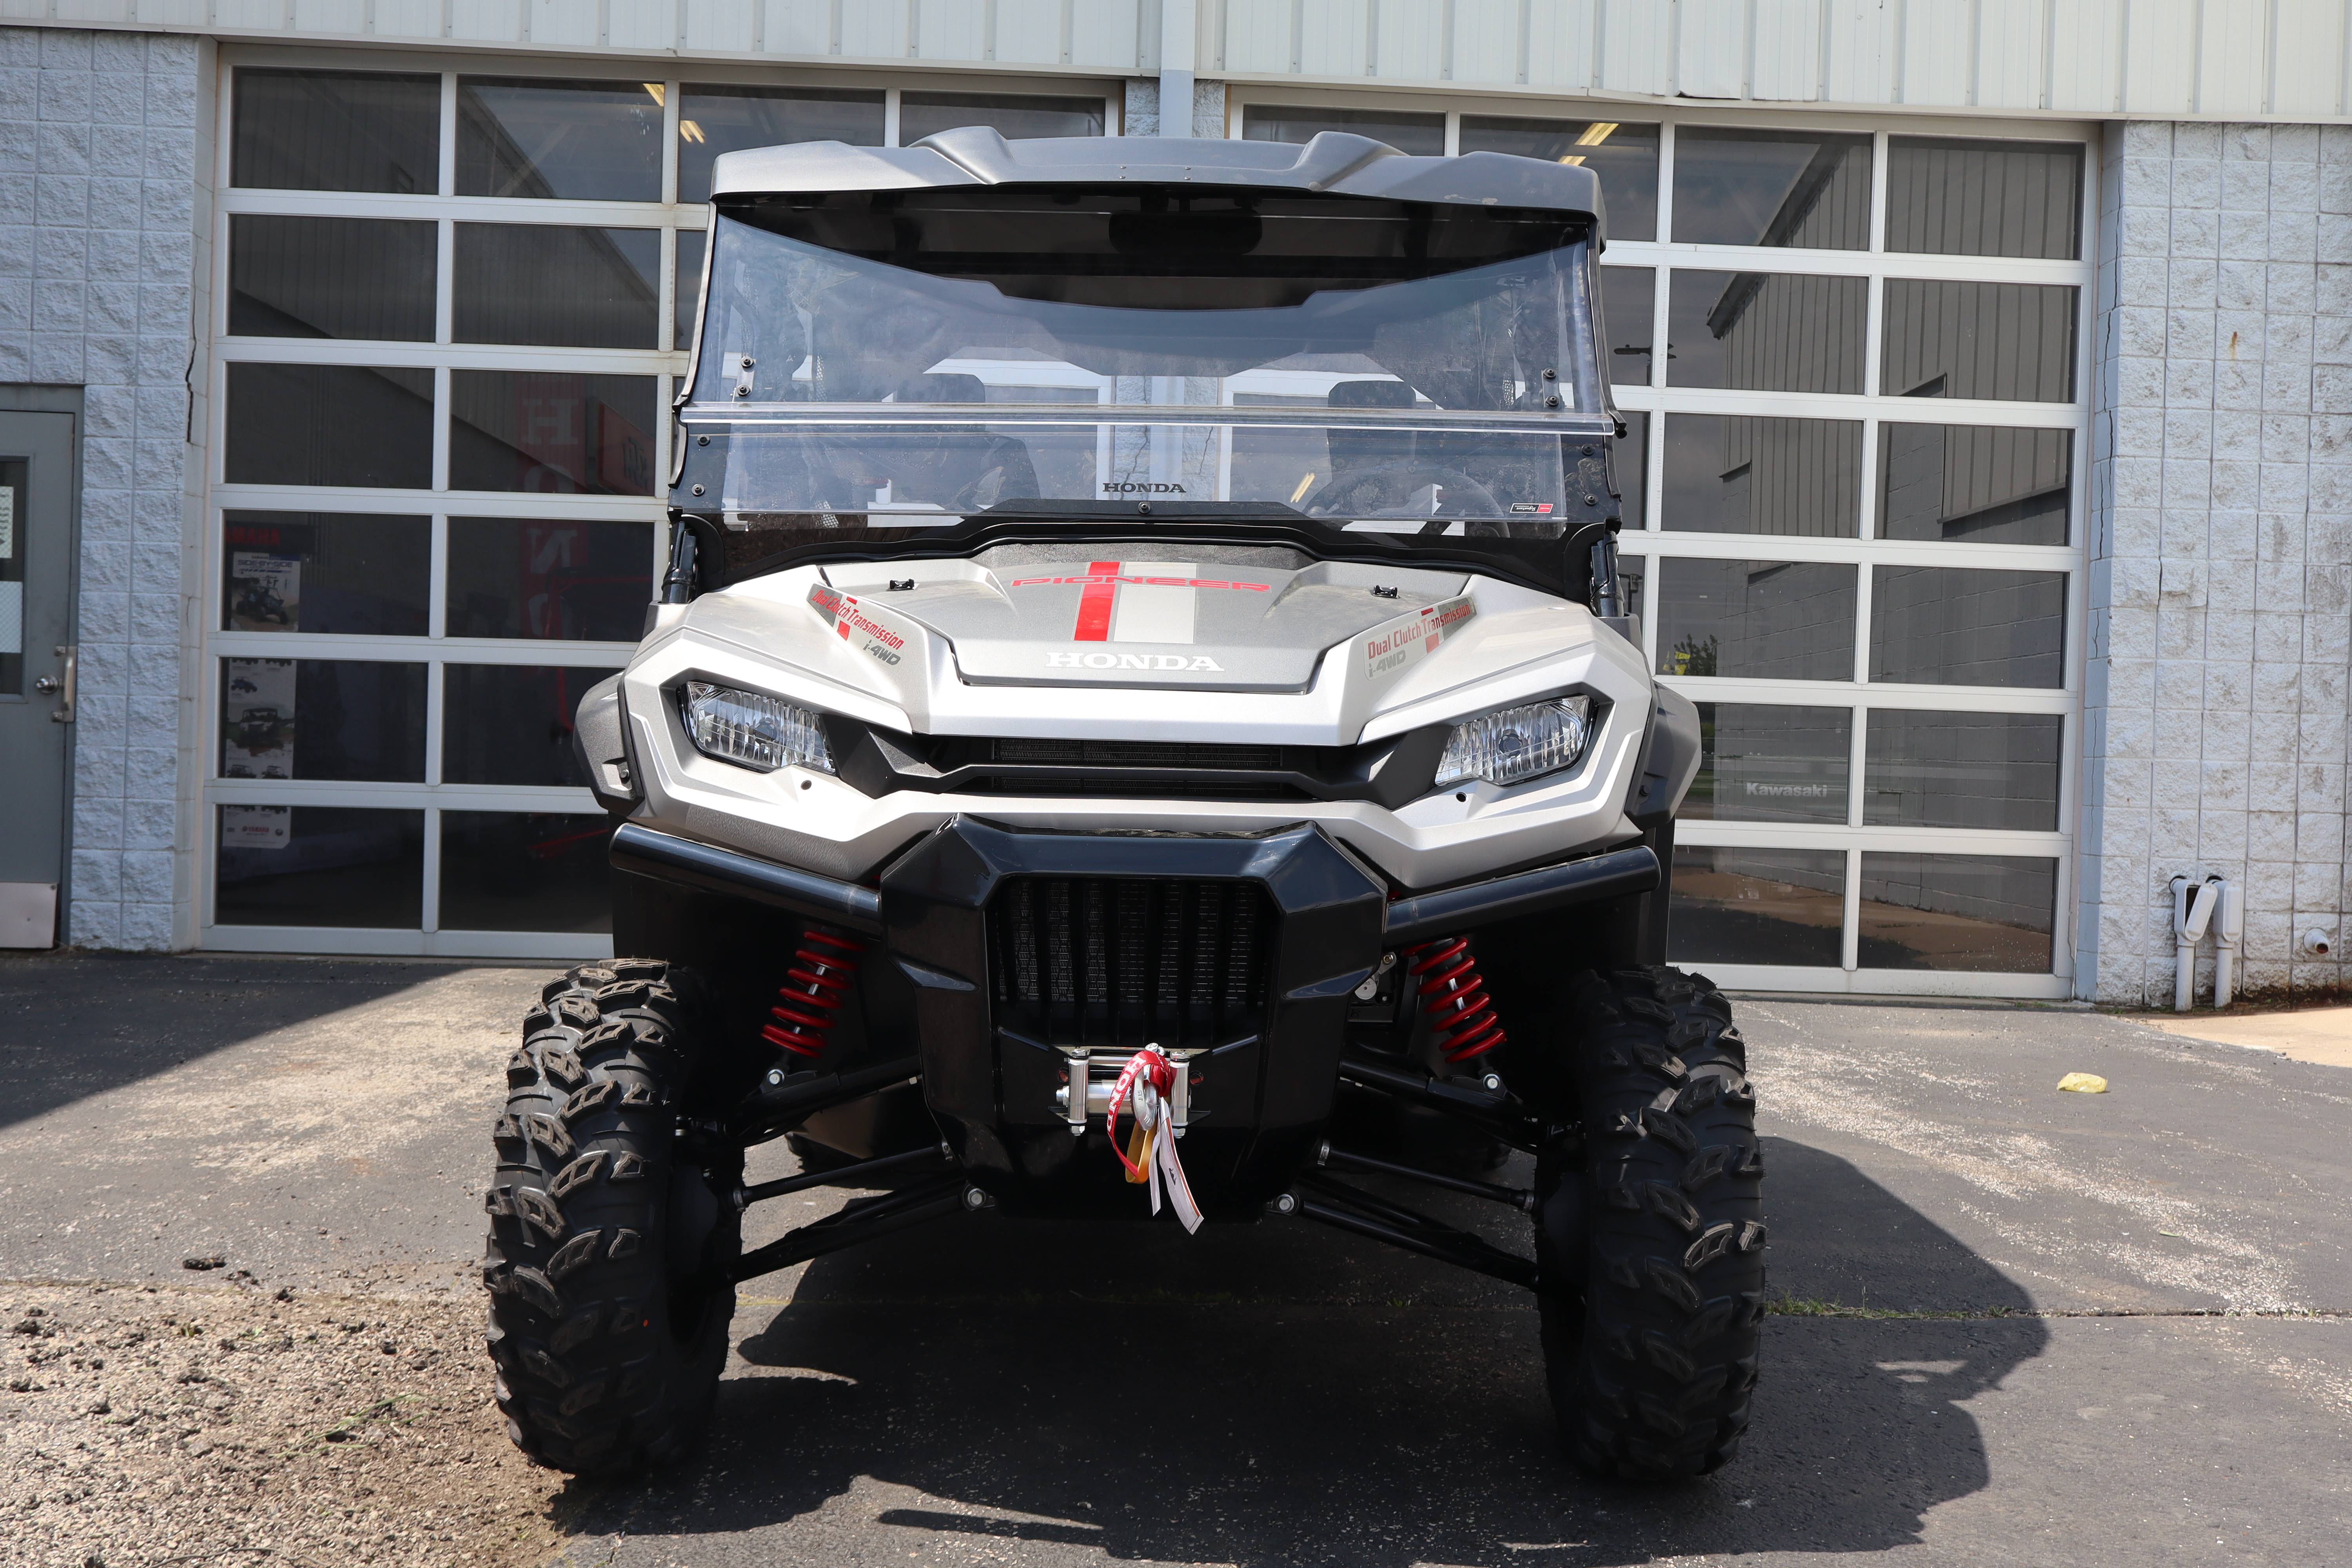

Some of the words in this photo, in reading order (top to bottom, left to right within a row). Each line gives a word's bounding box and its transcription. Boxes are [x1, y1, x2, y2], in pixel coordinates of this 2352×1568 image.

[1103, 483, 1187, 493] HONDA
[225, 526, 280, 546] AMAHA
[1011, 576, 1270, 592] PIONEER
[811, 590, 833, 606] Dual
[826, 598, 851, 619] Clutch
[847, 608, 904, 650] Transmission
[1368, 634, 1391, 659] Dual
[1394, 622, 1421, 648] Clutch
[1421, 604, 1472, 634] Transmission
[863, 639, 901, 666] i-4WD
[1045, 652, 1225, 671] HONDA
[1369, 649, 1406, 678] i-4WD
[1746, 782, 1827, 797] Kawasaki
